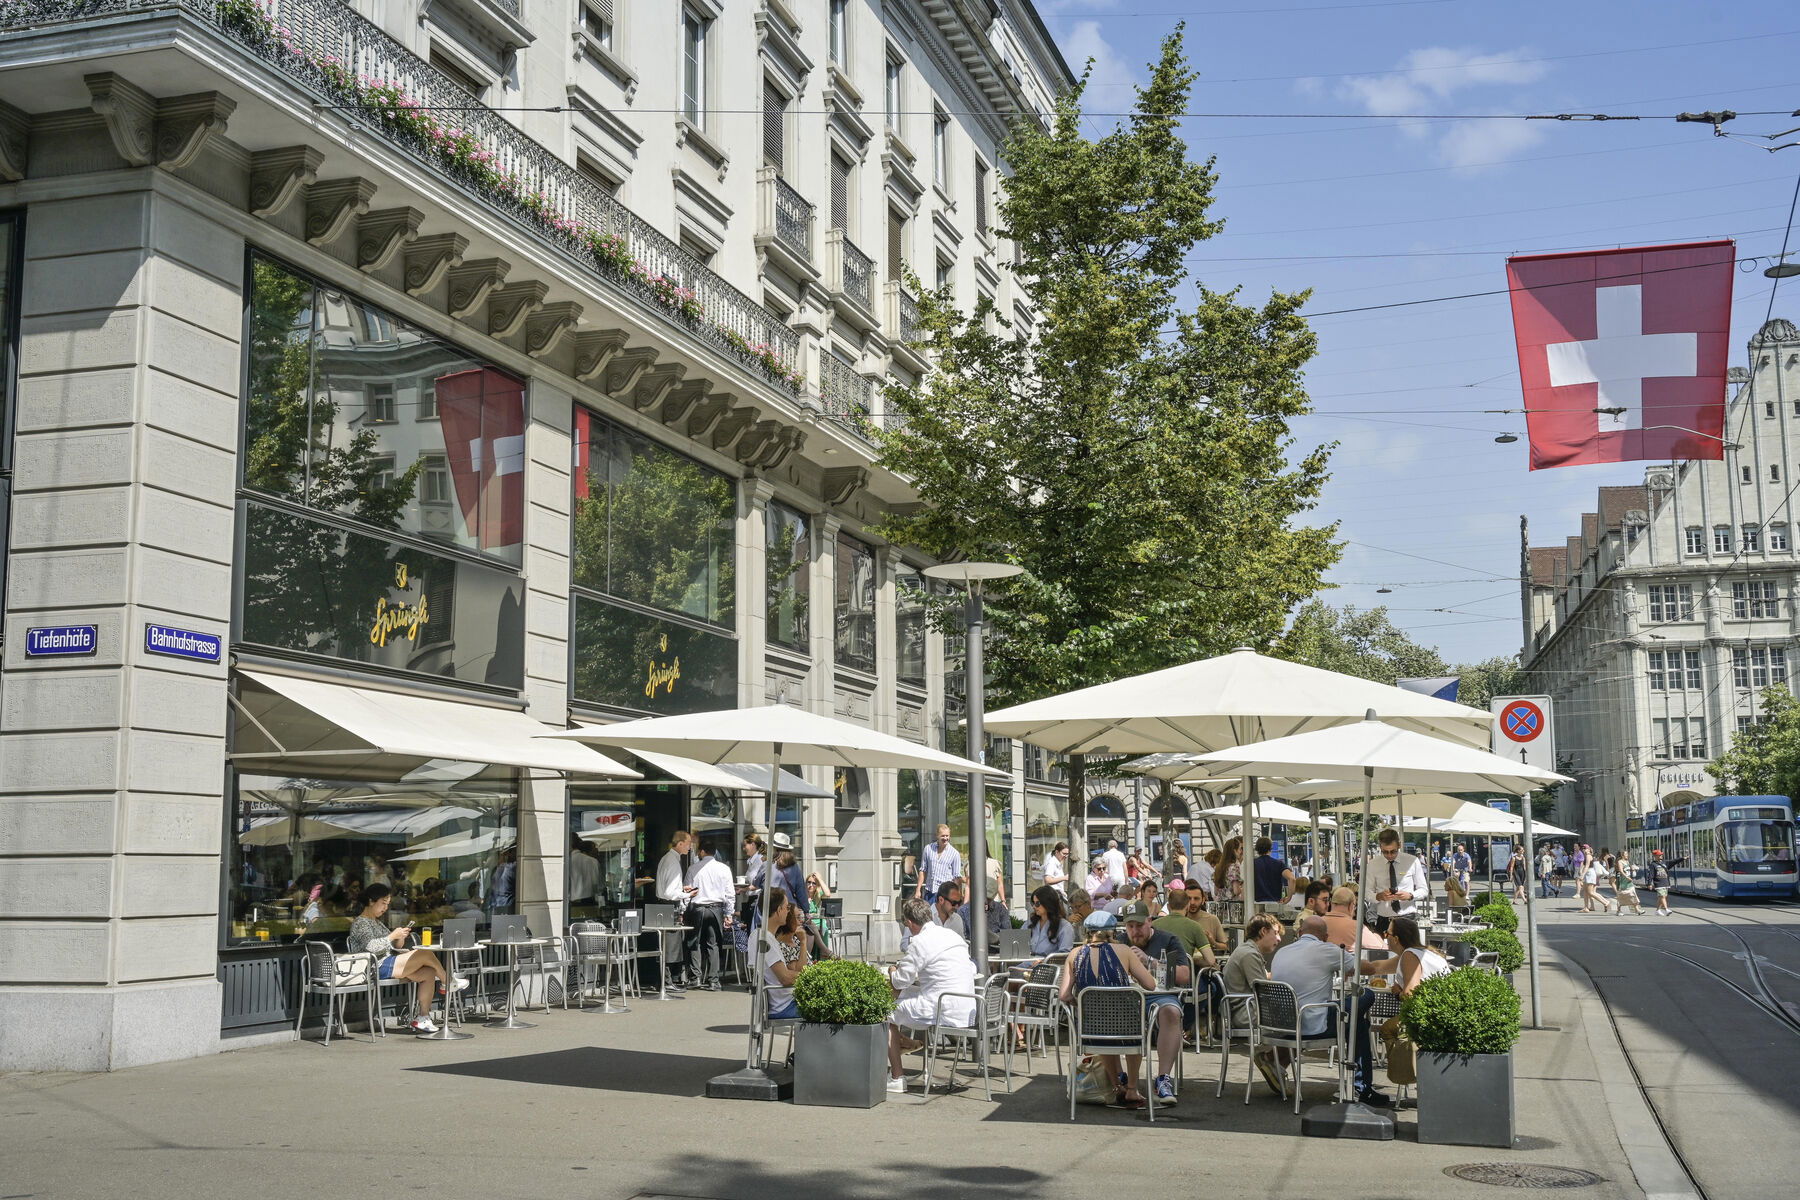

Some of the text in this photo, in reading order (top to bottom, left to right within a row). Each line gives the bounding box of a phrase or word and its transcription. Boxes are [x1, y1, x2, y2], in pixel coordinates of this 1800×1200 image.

[33, 628, 90, 649] Tiefenhöfe
[370, 594, 430, 648] Sprüngli
[151, 627, 217, 655] Bahnhofstrasse
[645, 656, 681, 699] Sprüngli
